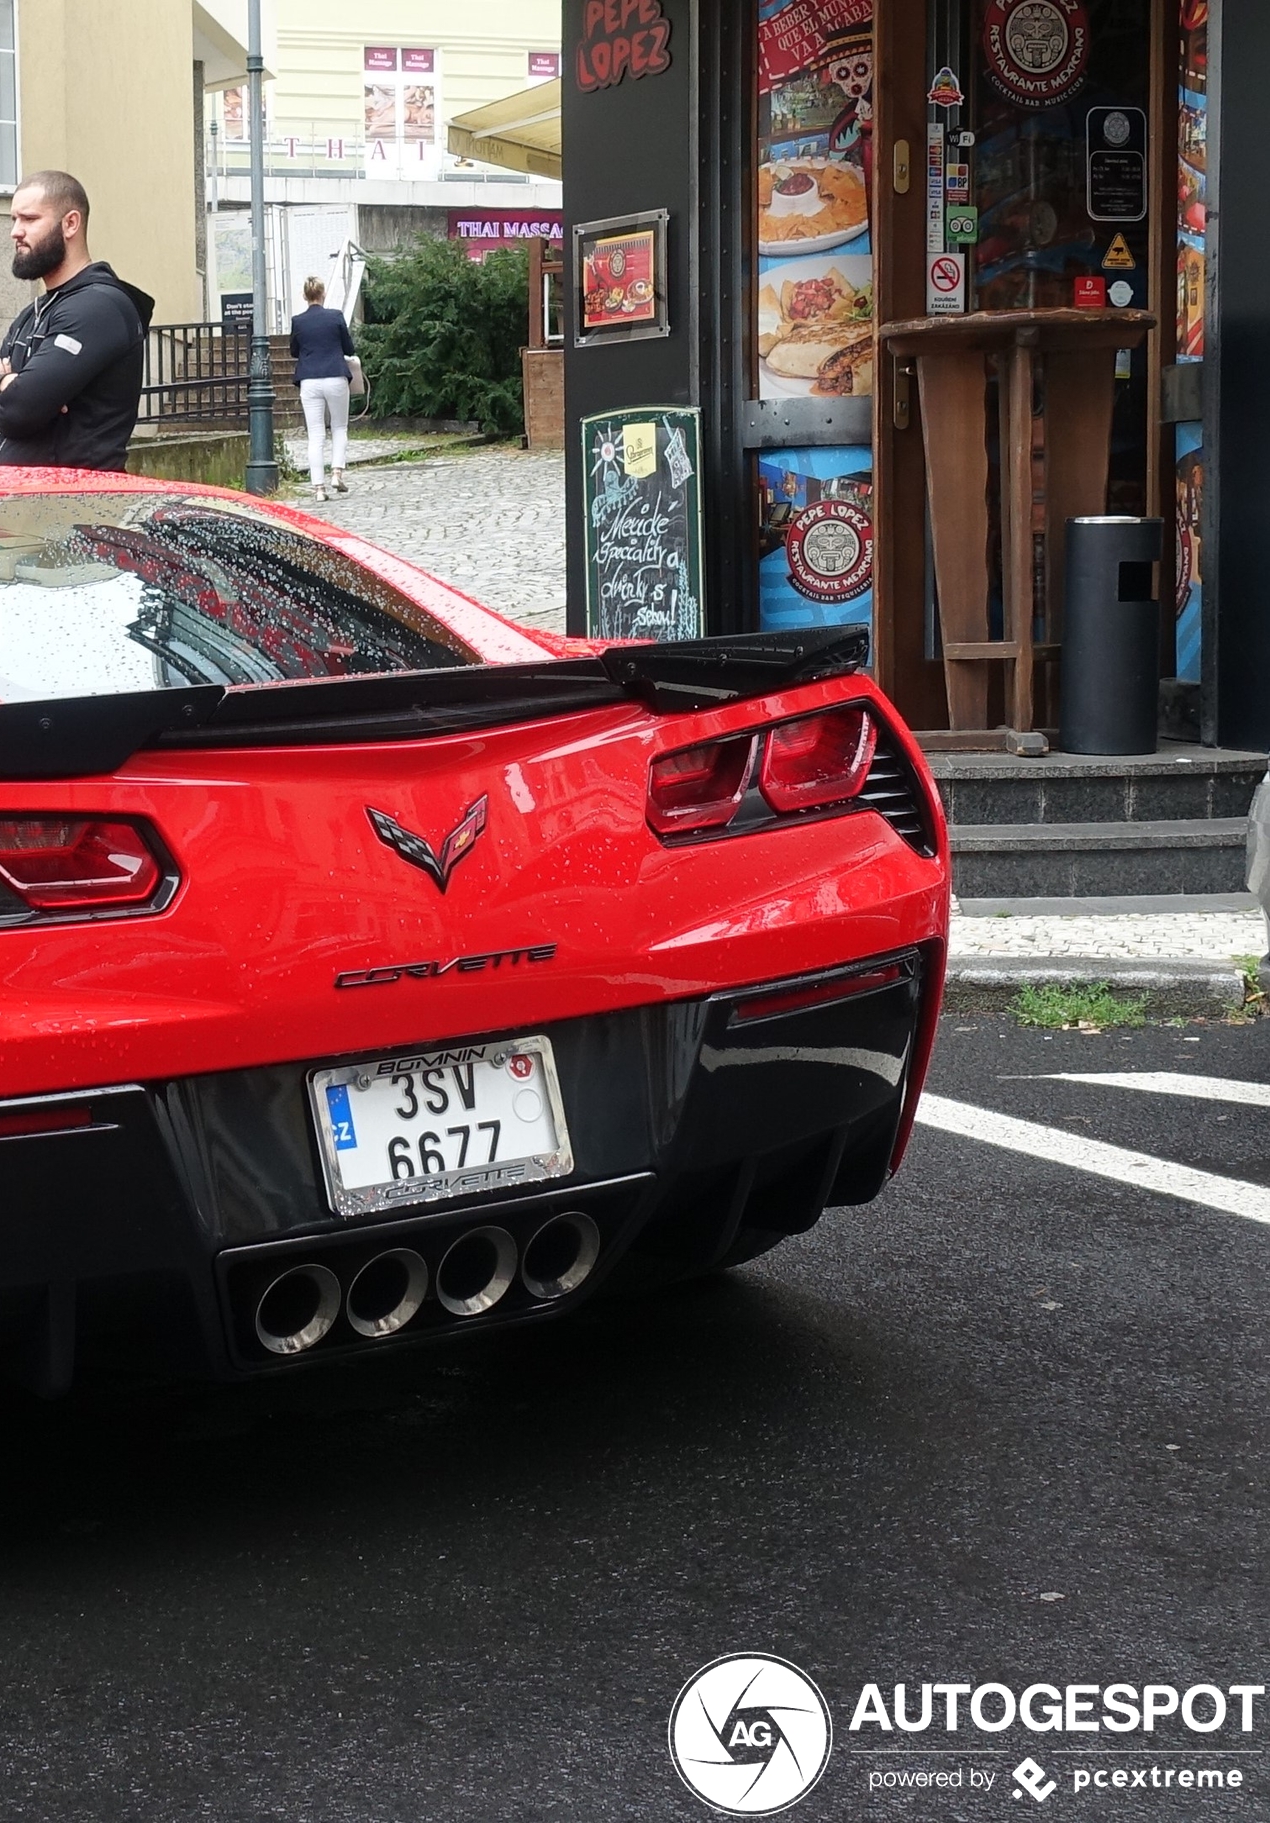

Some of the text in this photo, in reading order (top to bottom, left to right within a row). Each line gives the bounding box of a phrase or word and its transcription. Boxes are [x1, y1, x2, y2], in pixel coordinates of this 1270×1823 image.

[586, 0, 657, 40] PEPE
[772, 4, 811, 37] BEBER
[778, 28, 803, 51] QUE
[800, 17, 819, 37] EL
[578, 25, 666, 85] LOPEZ
[791, 41, 813, 61] VA
[990, 25, 1084, 92] RESTAURANTE MEXICANO
[991, 75, 1024, 104] COCKTAIL
[1044, 92, 1068, 107] MUSIC
[957, 176, 968, 188] BP
[456, 220, 563, 239] THAI MASSA
[795, 504, 870, 531] PEPE LOPEZ
[791, 539, 873, 590] RESTAURANTE MEXICANO
[792, 578, 820, 599] COCKTAIL
[334, 942, 557, 988] CORVETTE
[376, 1046, 486, 1076] BOMNIN
[391, 1063, 476, 1119] 3SV
[388, 1120, 501, 1181] 6677
[385, 1164, 526, 1200] CORVETTE
